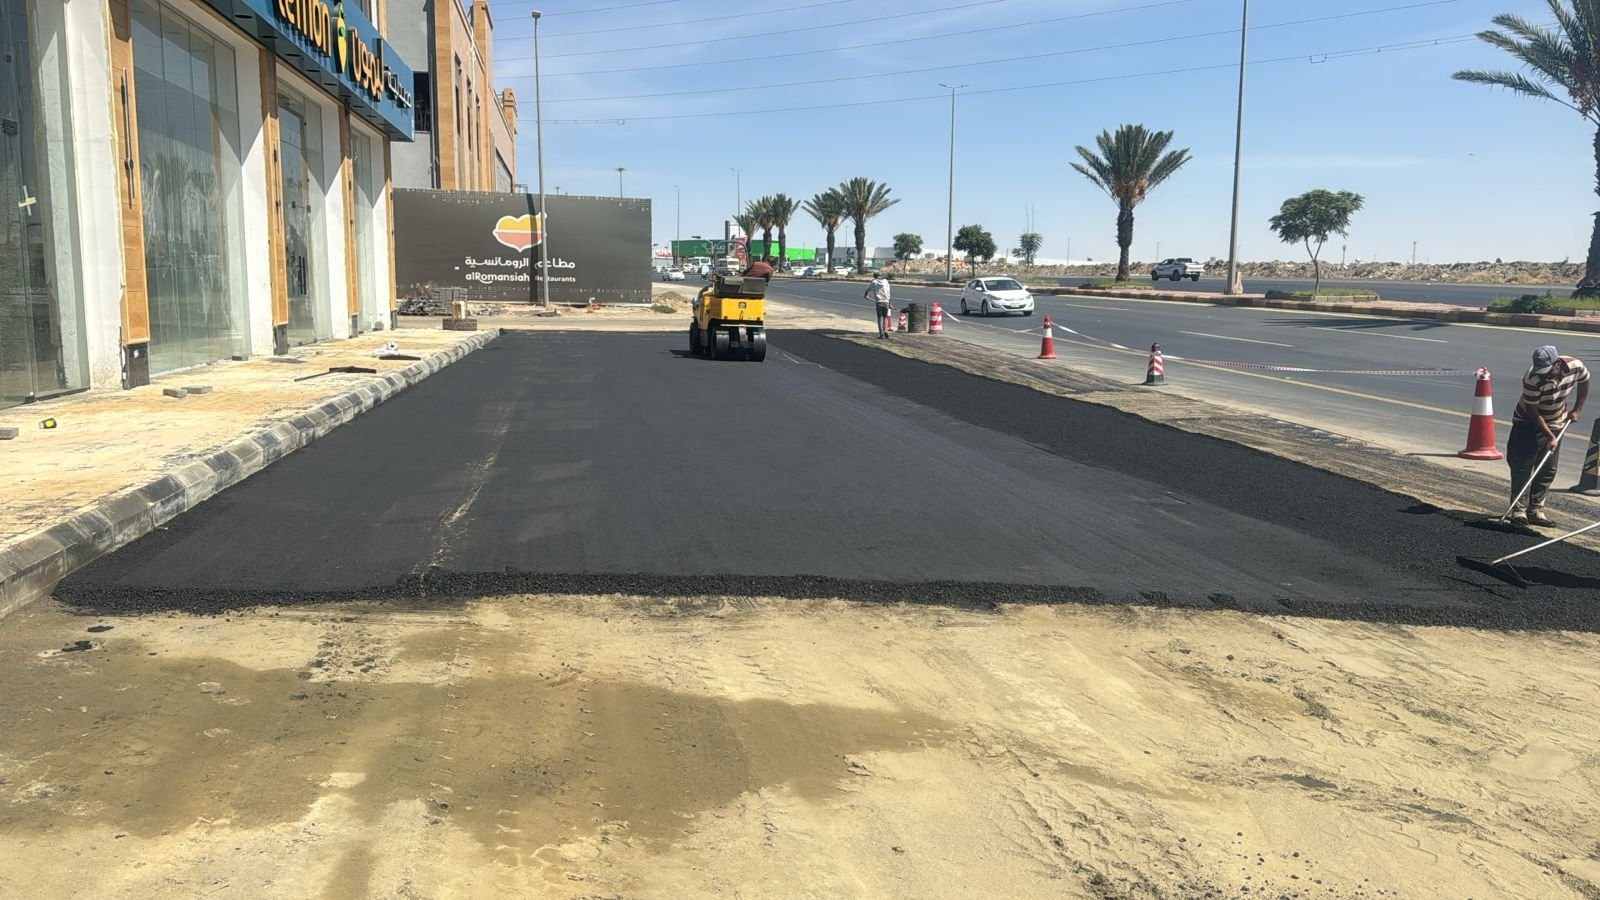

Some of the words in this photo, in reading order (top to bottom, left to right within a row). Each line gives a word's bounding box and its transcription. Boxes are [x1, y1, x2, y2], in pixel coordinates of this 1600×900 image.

[278, 0, 332, 57] mon
[351, 26, 385, 99] ليمون
[464, 256, 529, 269] الرومانسية
[465, 272, 530, 284] alRomansiah
[535, 275, 576, 283] Retaurants
